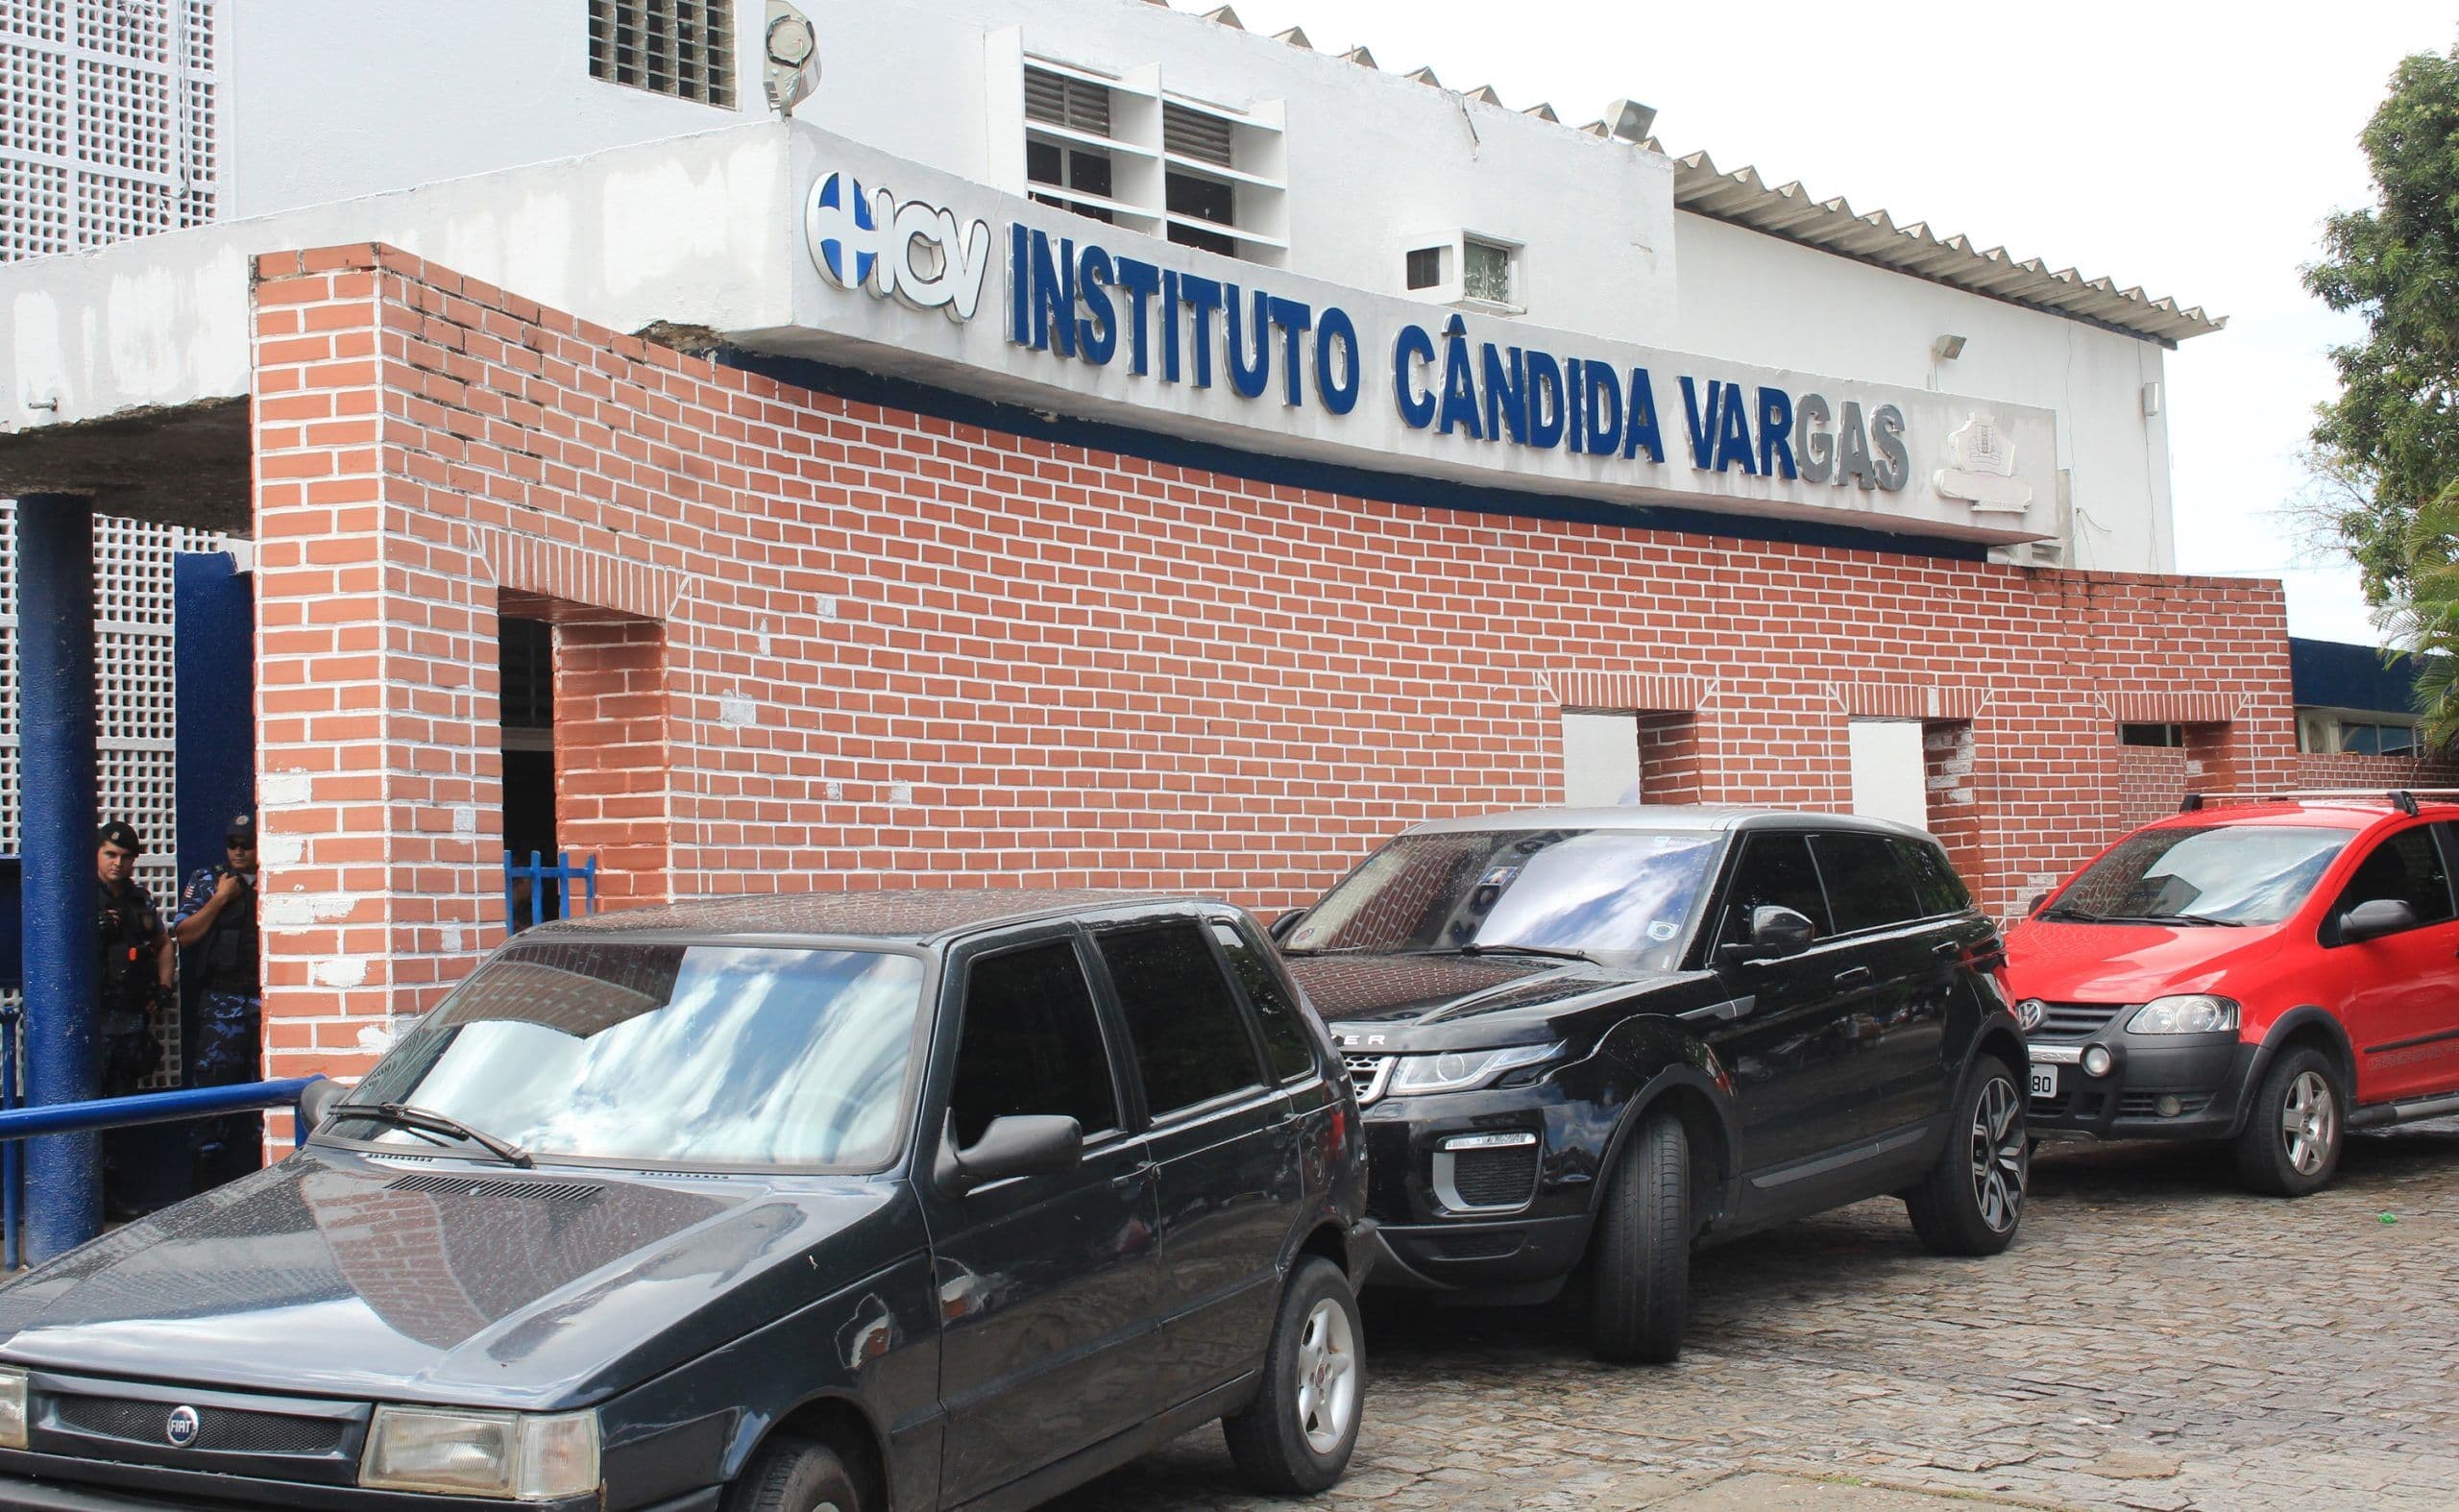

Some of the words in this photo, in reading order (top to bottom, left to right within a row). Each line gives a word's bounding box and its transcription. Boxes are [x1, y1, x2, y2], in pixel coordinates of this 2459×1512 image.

[1005, 221, 1360, 416] INSTITUTO
[1391, 312, 1665, 464] CÂNDIDA
[1677, 376, 1910, 493] VARGAS
[1330, 1035, 1385, 1046] ER
[171, 1420, 192, 1433] FIAT
